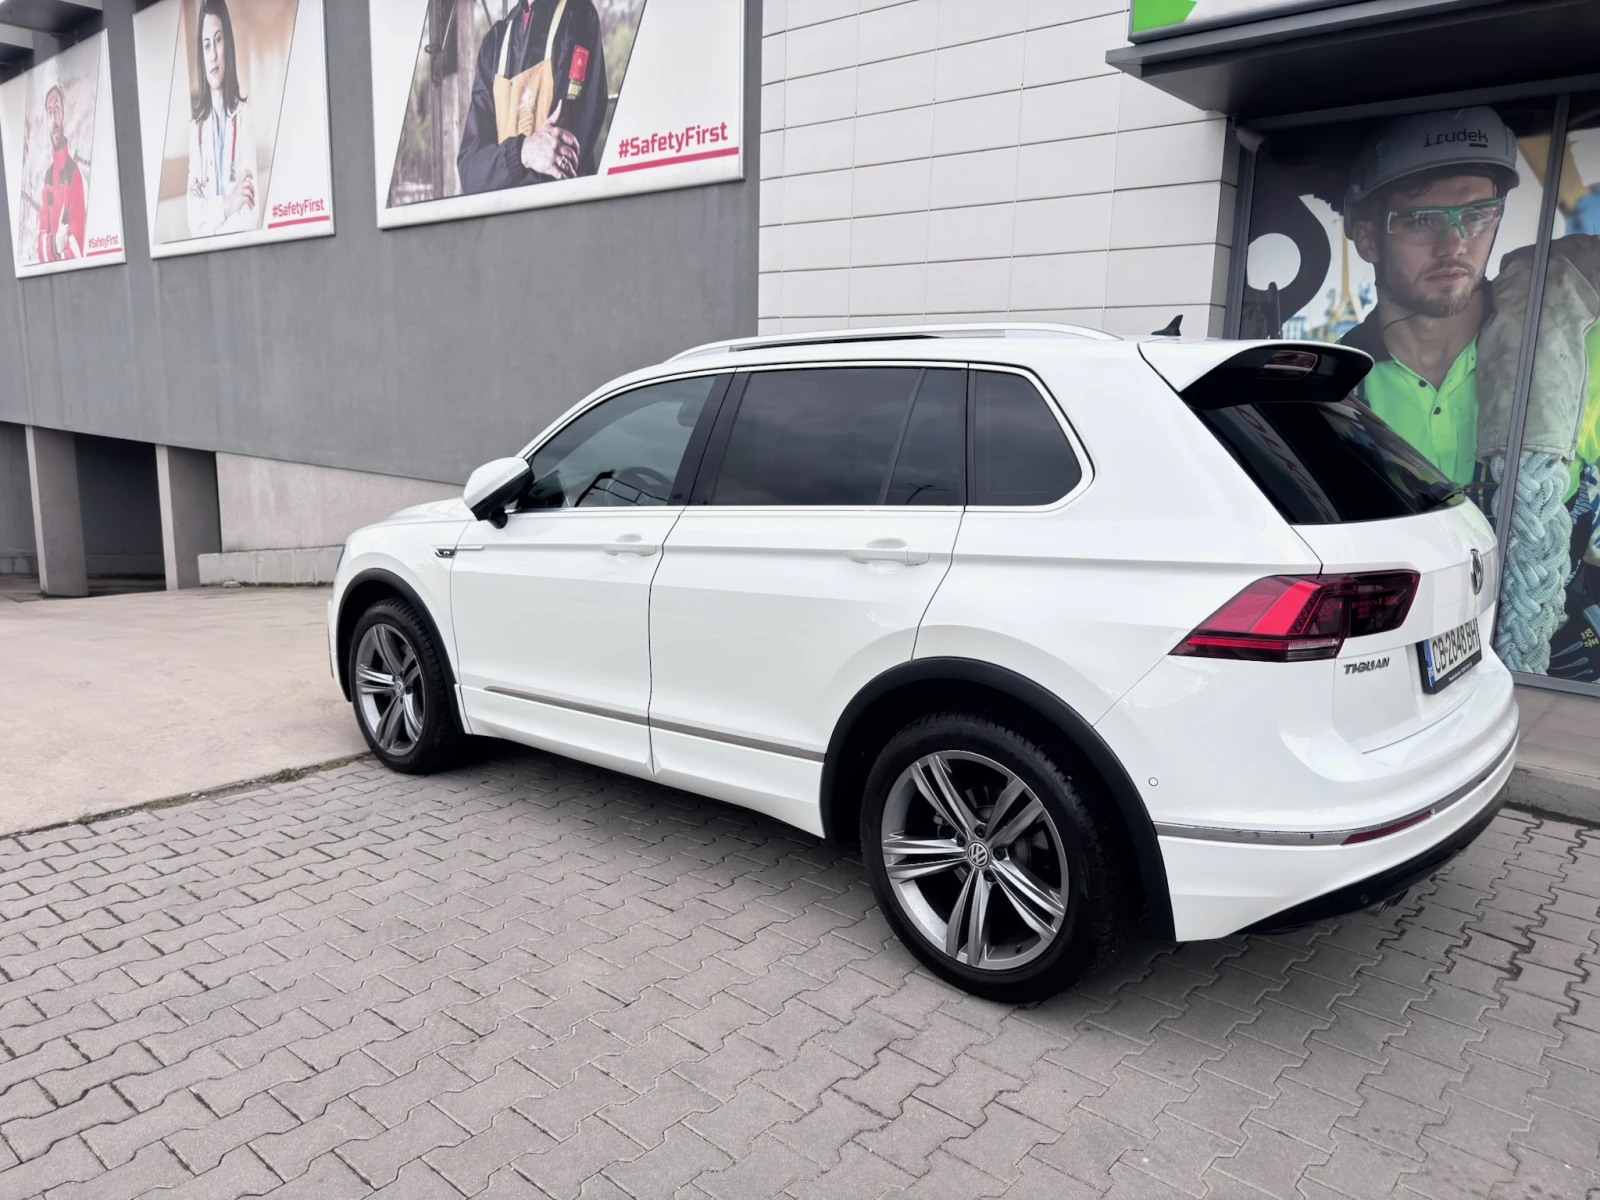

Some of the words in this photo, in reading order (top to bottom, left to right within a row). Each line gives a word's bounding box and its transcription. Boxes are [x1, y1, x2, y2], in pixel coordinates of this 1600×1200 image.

[618, 121, 728, 158] #SafetyFirst
[1422, 128, 1489, 148] irudek
[272, 197, 325, 218] #SafetyFirst
[88, 234, 119, 248] #SafetyFirst
[1343, 657, 1390, 675] TIGUAN
